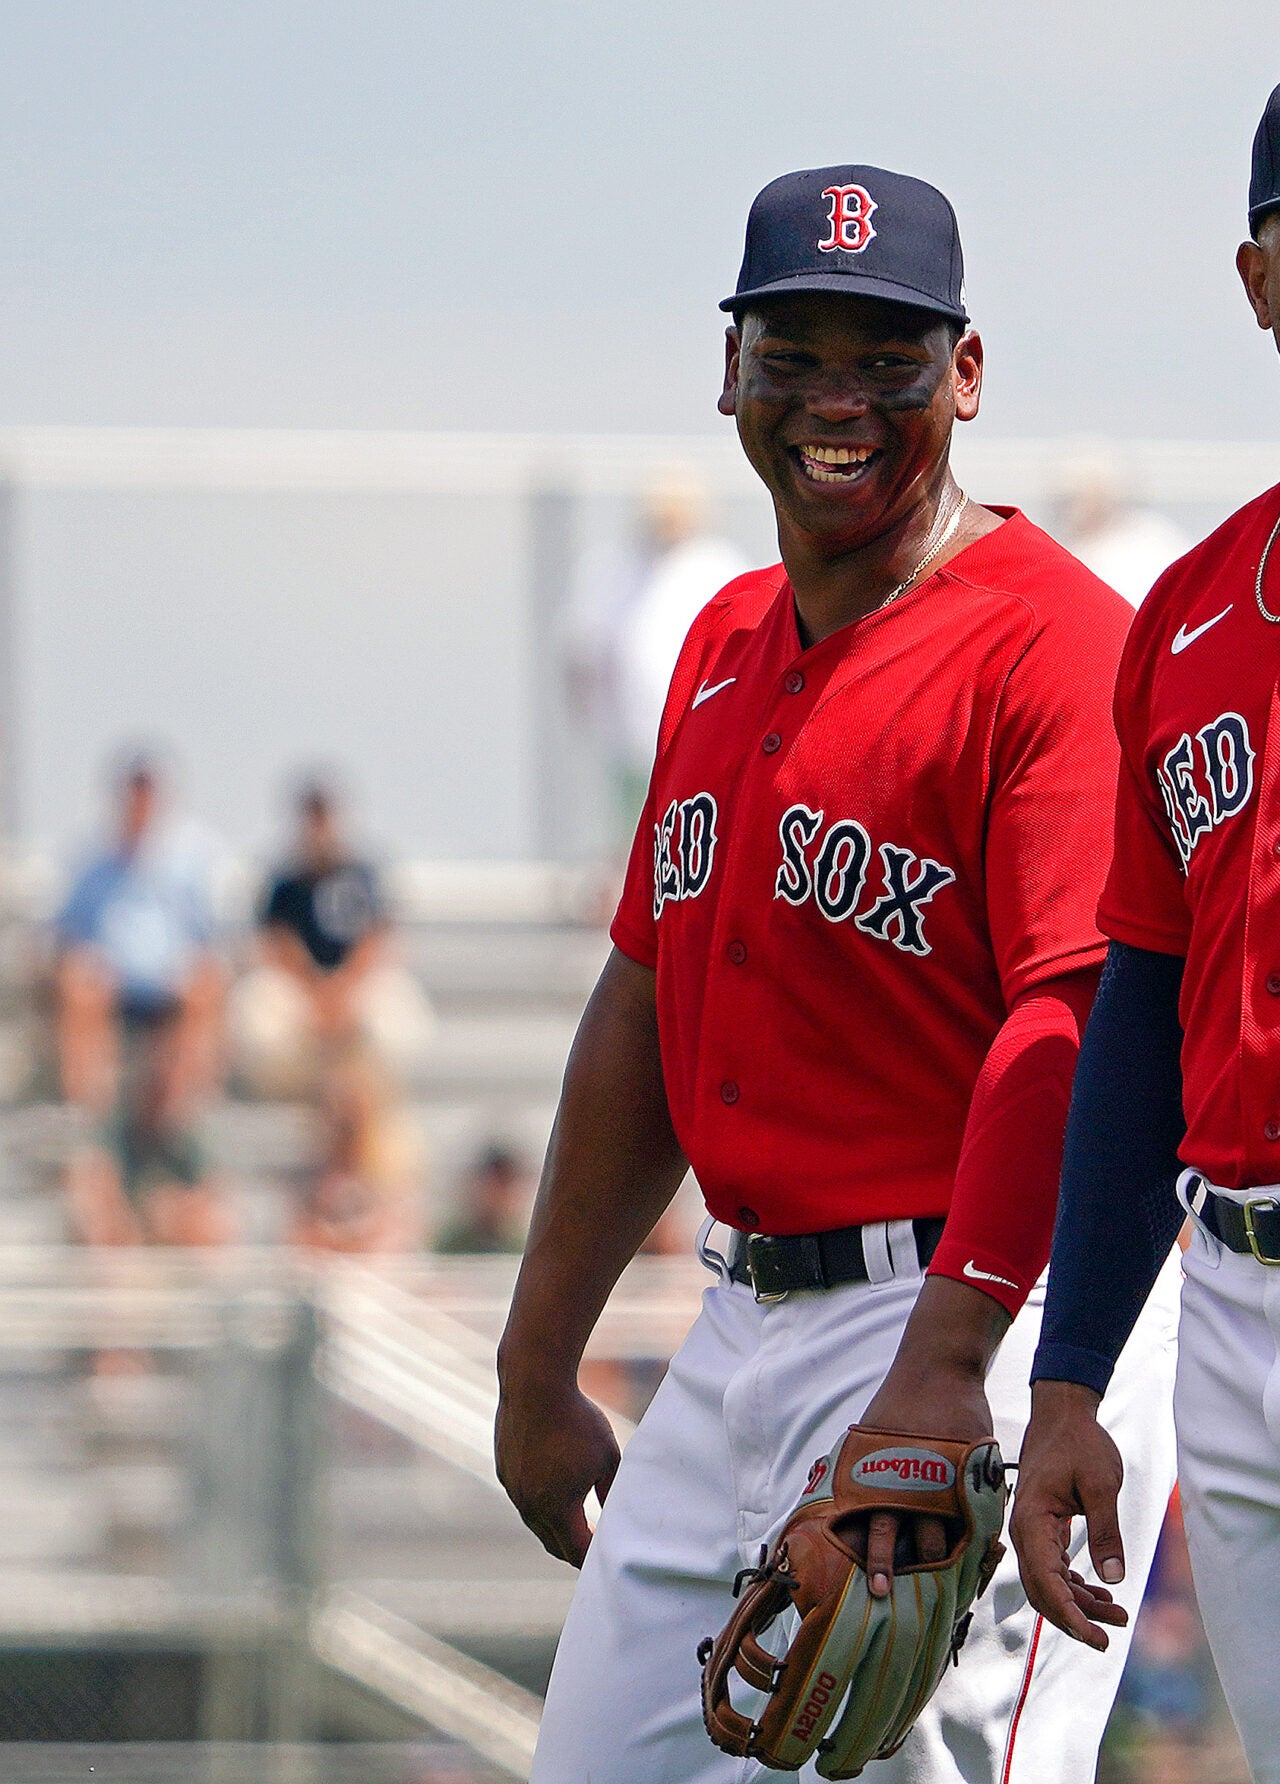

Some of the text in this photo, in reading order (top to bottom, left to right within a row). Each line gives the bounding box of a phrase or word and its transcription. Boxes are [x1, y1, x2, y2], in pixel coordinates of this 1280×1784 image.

[818, 184, 878, 253] B
[774, 803, 956, 956] SOX
[860, 1458, 948, 1485] Wilson
[791, 1671, 838, 1743] A2000
